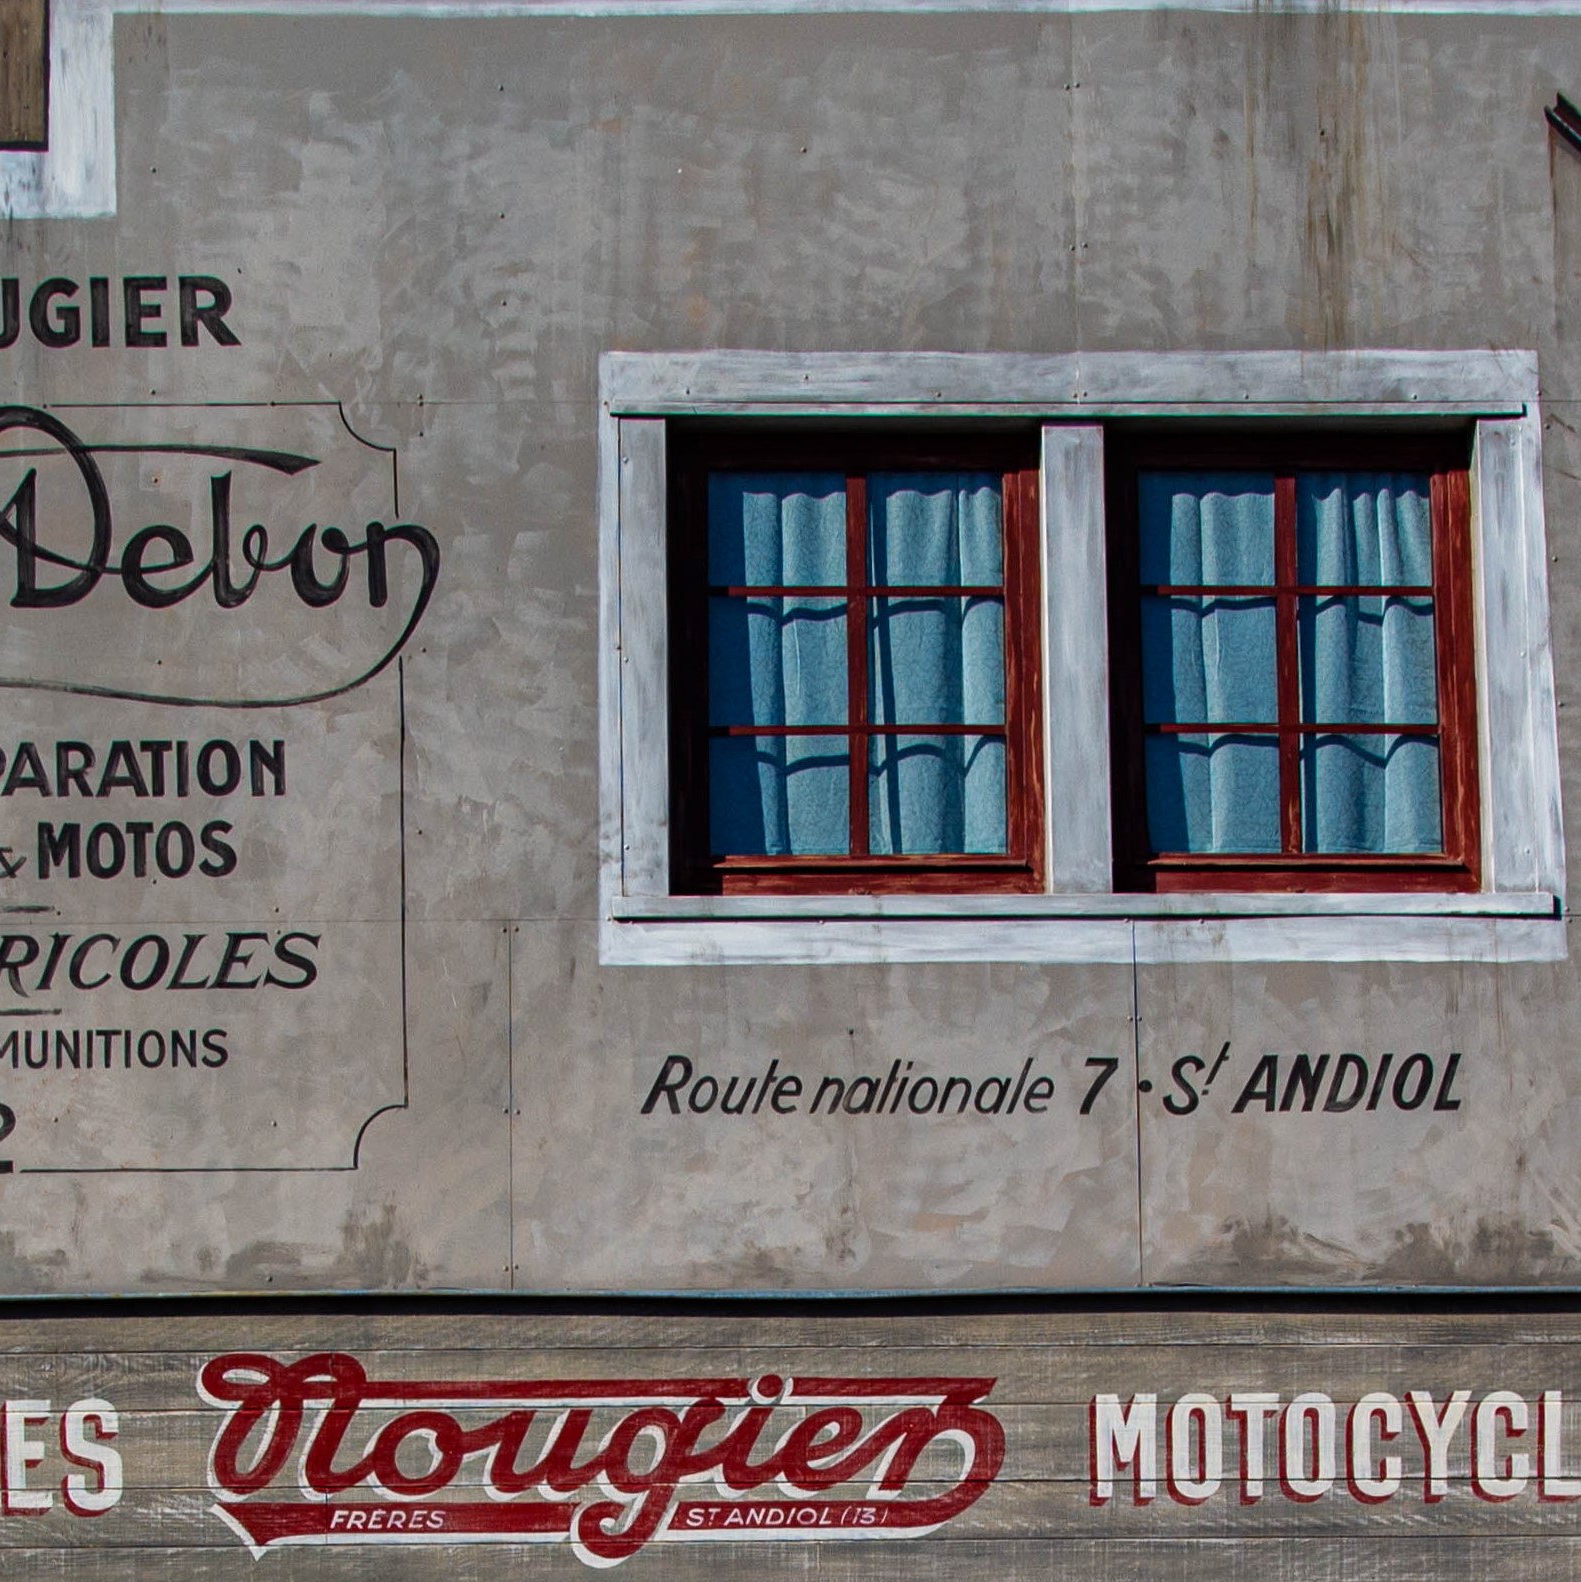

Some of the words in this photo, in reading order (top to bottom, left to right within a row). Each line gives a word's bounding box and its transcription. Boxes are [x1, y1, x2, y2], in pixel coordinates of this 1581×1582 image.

[37, 821, 239, 882] MOTOS
[640, 1053, 804, 1117] Route
[809, 1055, 1056, 1117] nationale
[1079, 1057, 1121, 1117] 7
[1231, 1051, 1463, 1117] ANDIOL
[196, 1353, 1007, 1569] Nougier
[723, 1506, 832, 1527] ANDIOL
[839, 1505, 891, 1527] (13)
